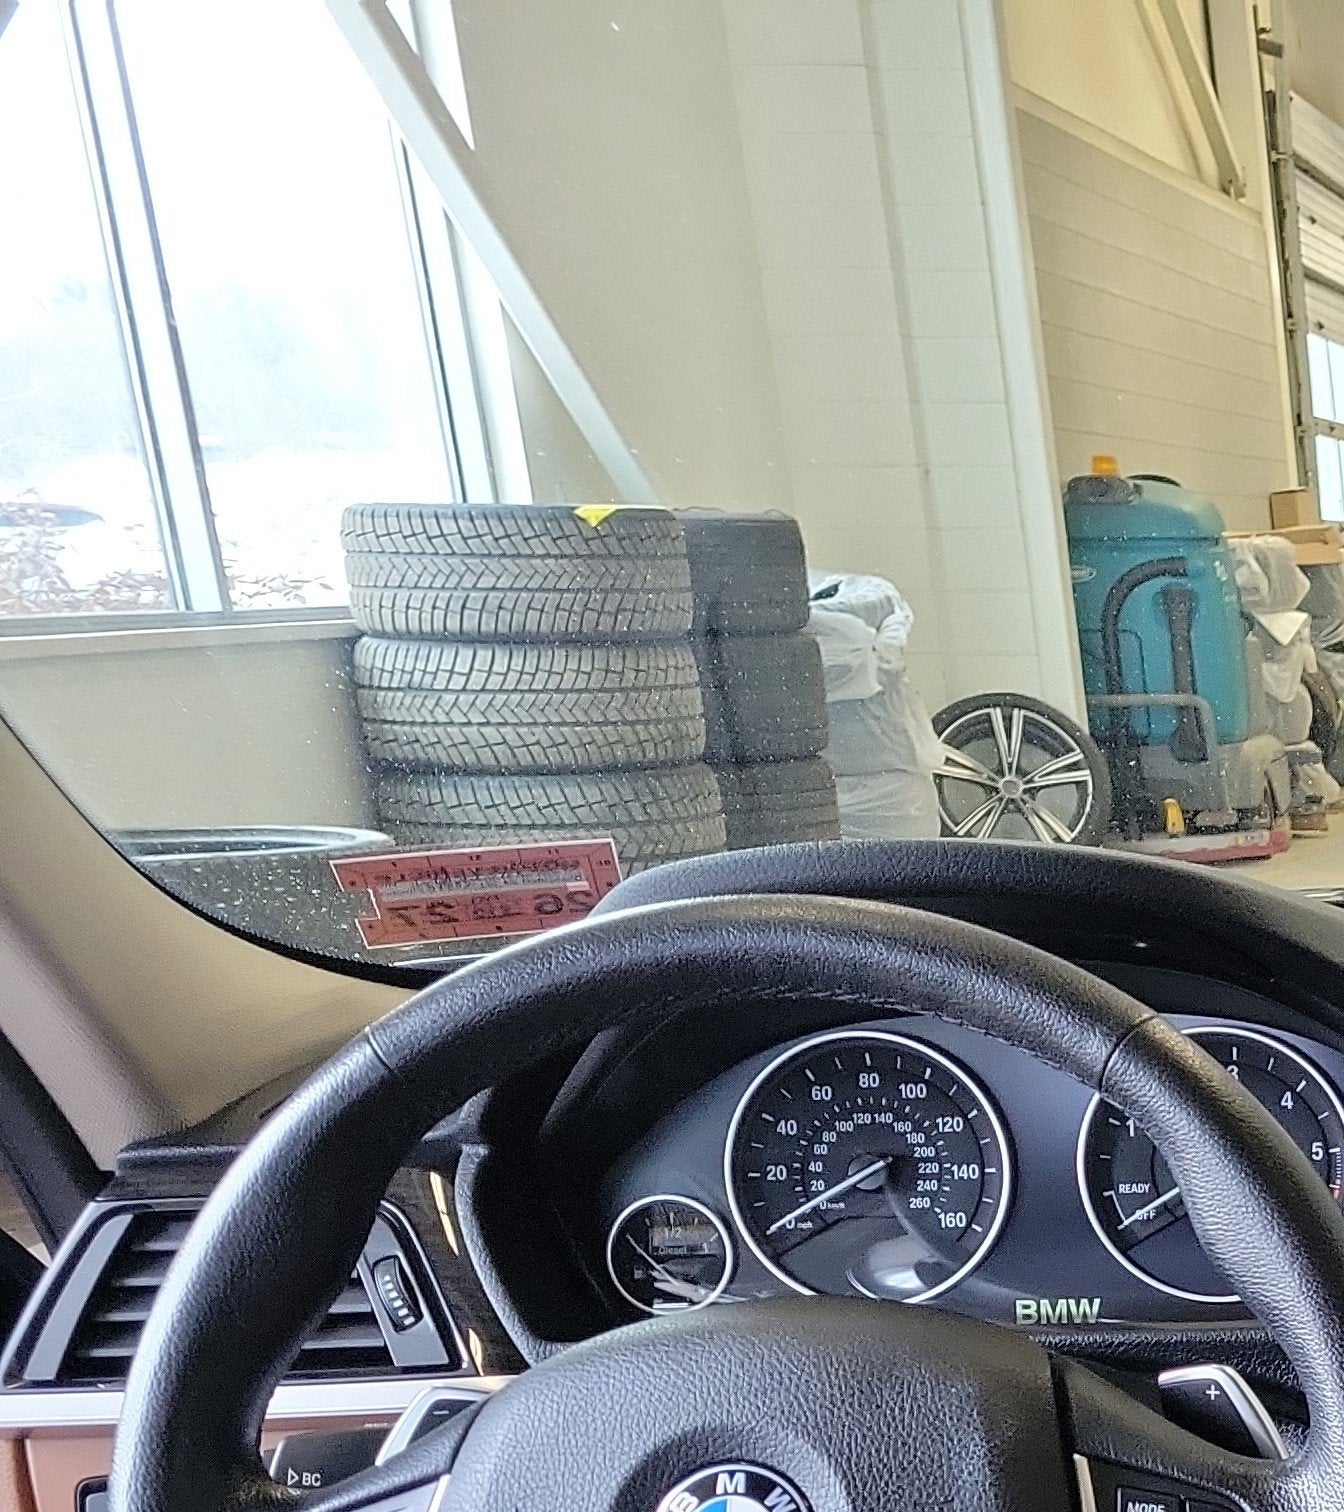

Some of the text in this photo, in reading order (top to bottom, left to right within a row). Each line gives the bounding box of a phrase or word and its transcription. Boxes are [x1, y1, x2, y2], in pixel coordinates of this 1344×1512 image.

[859, 1072, 880, 1088] 80
[811, 1086, 832, 1100] 60
[898, 1083, 927, 1098] 100
[1280, 1091, 1293, 1110] 4
[852, 1113, 871, 1124] 120
[874, 1113, 893, 1124] 140
[936, 1117, 963, 1132] 120
[776, 1119, 798, 1135] 40
[834, 1121, 854, 1132] 100
[893, 1121, 912, 1133] 160
[1126, 1118, 1135, 1137] 1
[822, 1131, 837, 1142] 80
[906, 1133, 925, 1144] 180
[813, 1144, 828, 1155] 60
[913, 1146, 935, 1157] 200
[1311, 1142, 1323, 1161] 5
[766, 1165, 787, 1181] 20
[808, 1161, 823, 1173] 40
[918, 1163, 939, 1174] 220
[951, 1163, 979, 1179] 140
[810, 1180, 825, 1191] 20
[916, 1180, 938, 1191] 240
[1118, 1183, 1150, 1194] READY
[909, 1197, 931, 1209] 260
[938, 1212, 966, 1228] 160
[1015, 1297, 1101, 1325] BMW
[302, 1471, 322, 1486] BC
